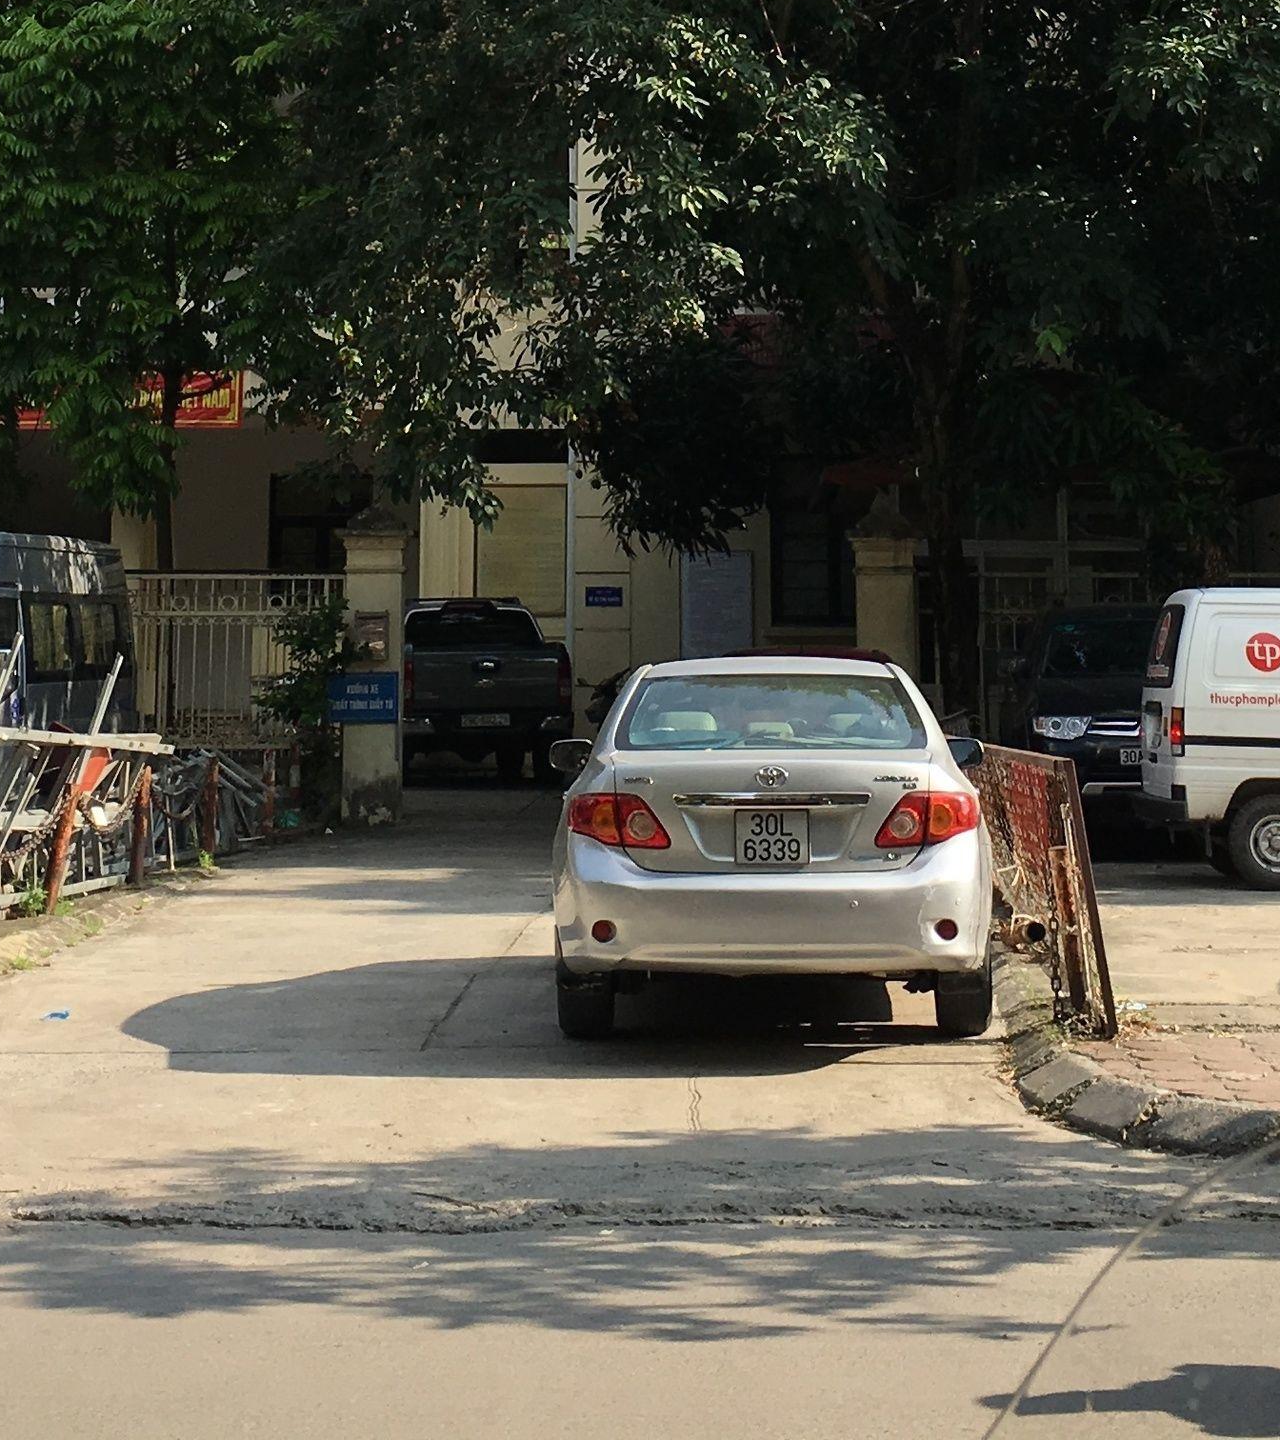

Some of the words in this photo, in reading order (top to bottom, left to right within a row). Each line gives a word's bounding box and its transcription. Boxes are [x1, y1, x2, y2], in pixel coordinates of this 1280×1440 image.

[202, 388, 230, 408] NAM
[1247, 639, 1280, 668] tp
[750, 814, 793, 837] 30L
[743, 838, 801, 861] 6339
